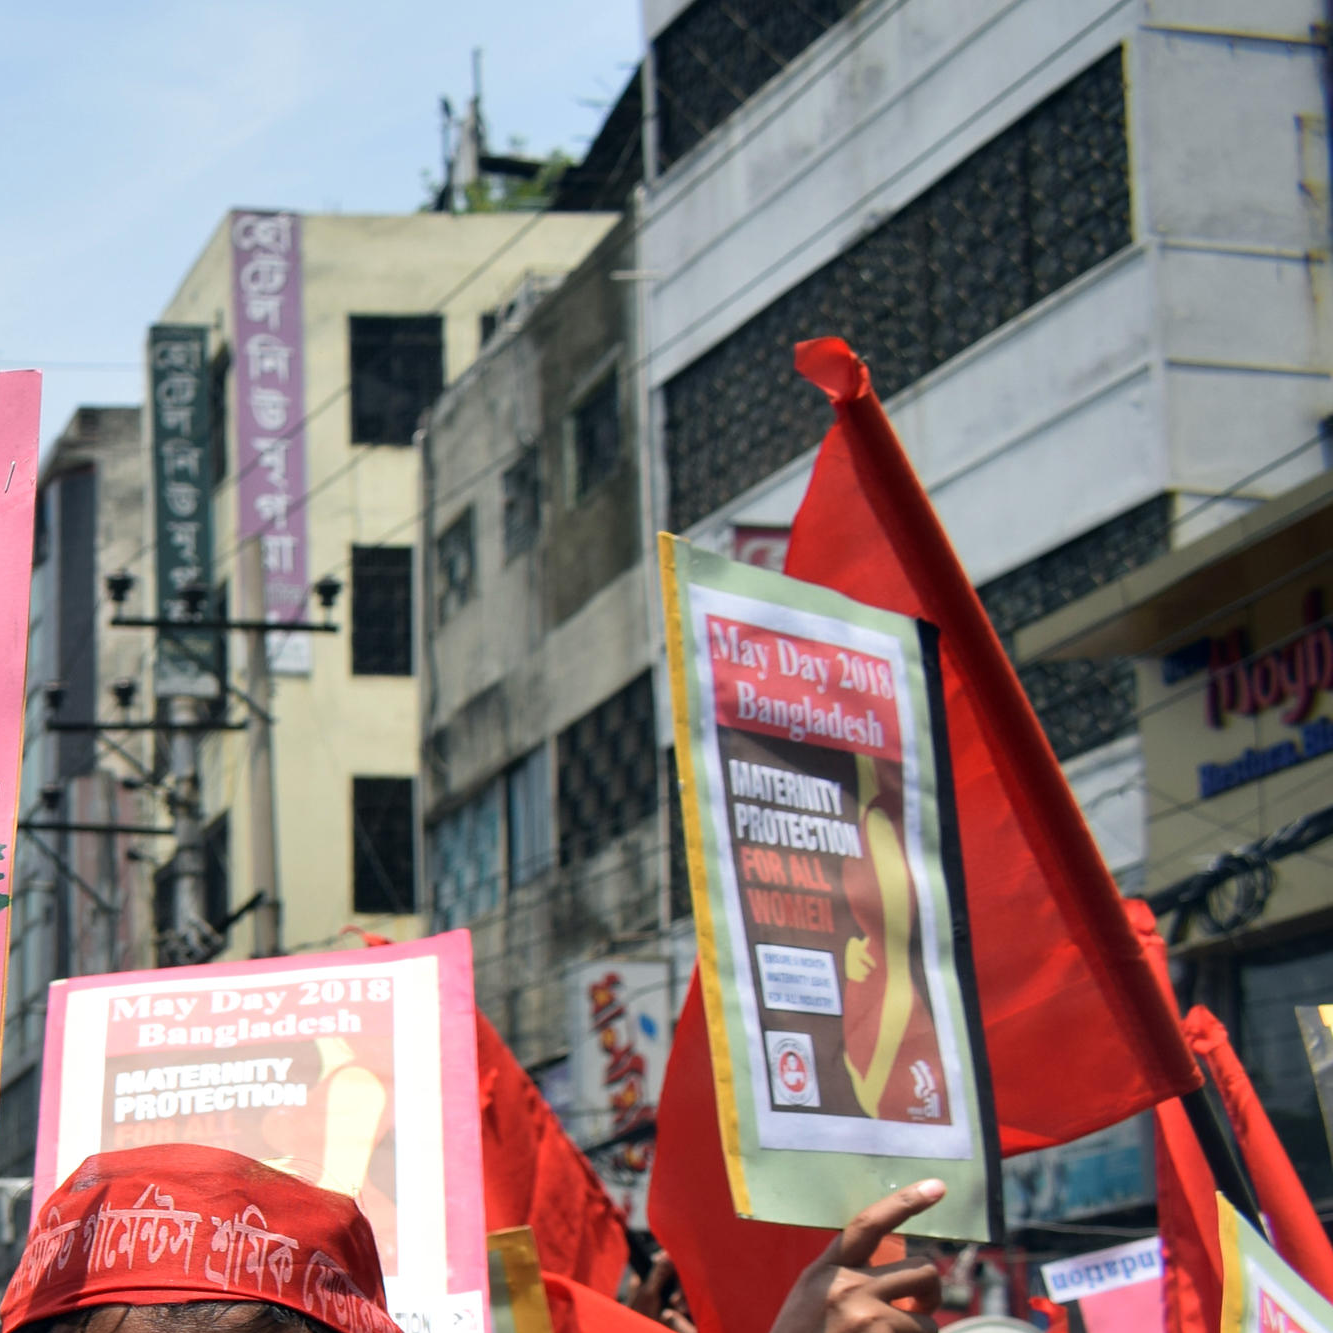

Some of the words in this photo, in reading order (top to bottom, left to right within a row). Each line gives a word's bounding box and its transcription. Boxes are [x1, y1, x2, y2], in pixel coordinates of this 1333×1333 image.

[710, 621, 770, 680] May
[777, 638, 829, 694] Day
[836, 653, 896, 700] 2018
[736, 680, 884, 742] Bangladesh
[729, 759, 843, 815] MATERNITY
[734, 803, 863, 858] PROTECTION
[741, 846, 787, 884] FOR
[788, 854, 832, 892] ALL
[746, 888, 834, 933] WOMEN
[112, 996, 198, 1021] May
[210, 989, 288, 1015] Day
[299, 979, 393, 1006] 2018
[137, 1009, 362, 1048] Bangladesh
[115, 1057, 293, 1095] MATERNITY
[114, 1083, 307, 1123] PROTECTION
[1051, 1250, 1156, 1291] ndation
